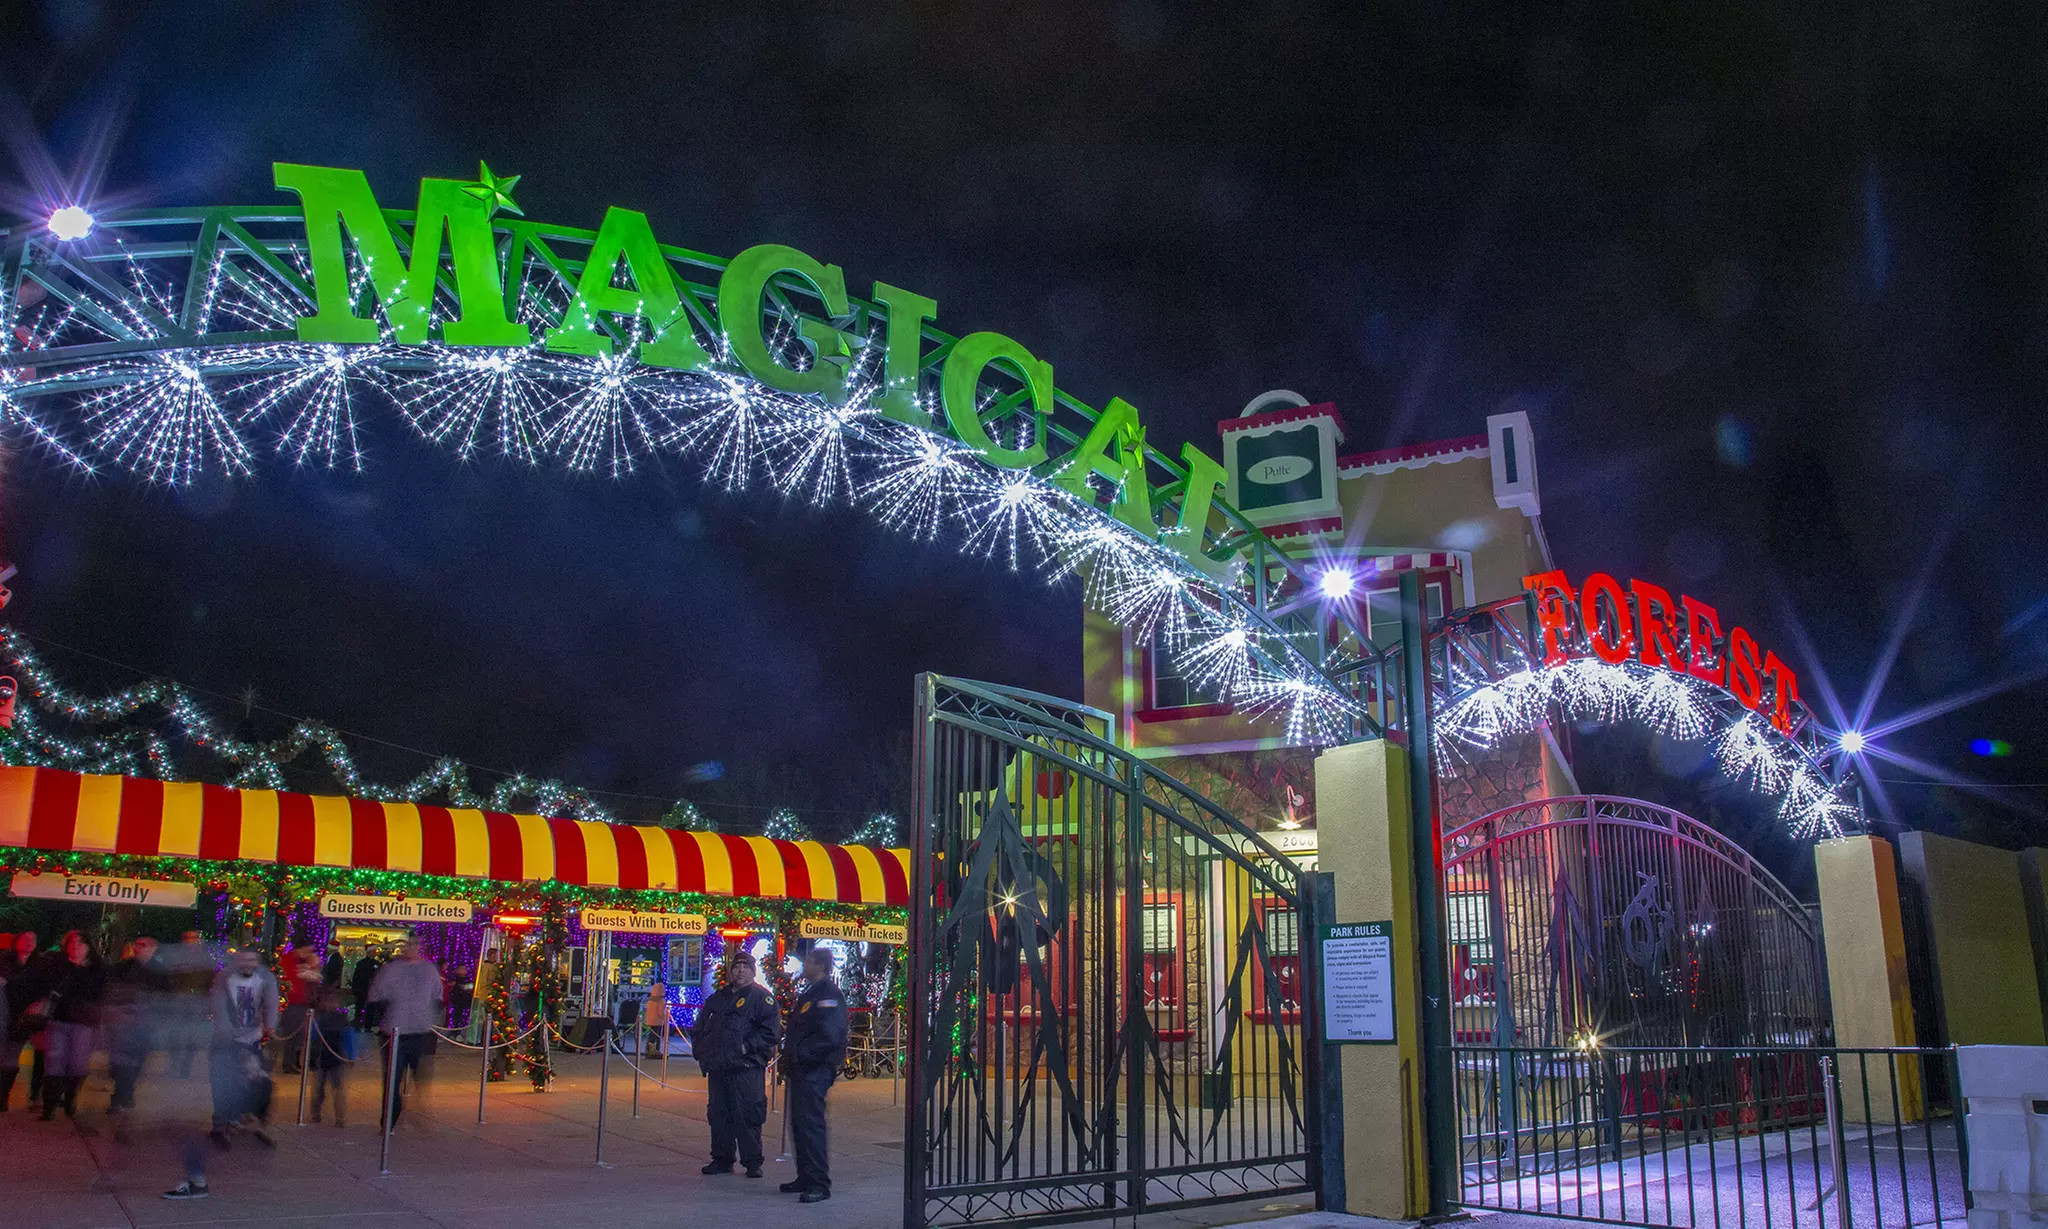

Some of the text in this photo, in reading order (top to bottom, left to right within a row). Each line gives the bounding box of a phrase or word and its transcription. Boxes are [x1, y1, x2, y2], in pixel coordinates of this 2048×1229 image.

[273, 162, 1248, 588] MAGICAL
[1522, 569, 1798, 738] FOREST
[64, 879, 150, 903] Exit Only
[327, 899, 466, 918] Guests With Tickets
[587, 913, 702, 930] Guests With Tickets
[805, 923, 903, 941] Guests With Tickets
[1330, 925, 1381, 938] PARK RULES
[1347, 1028, 1372, 1037] Thank you
